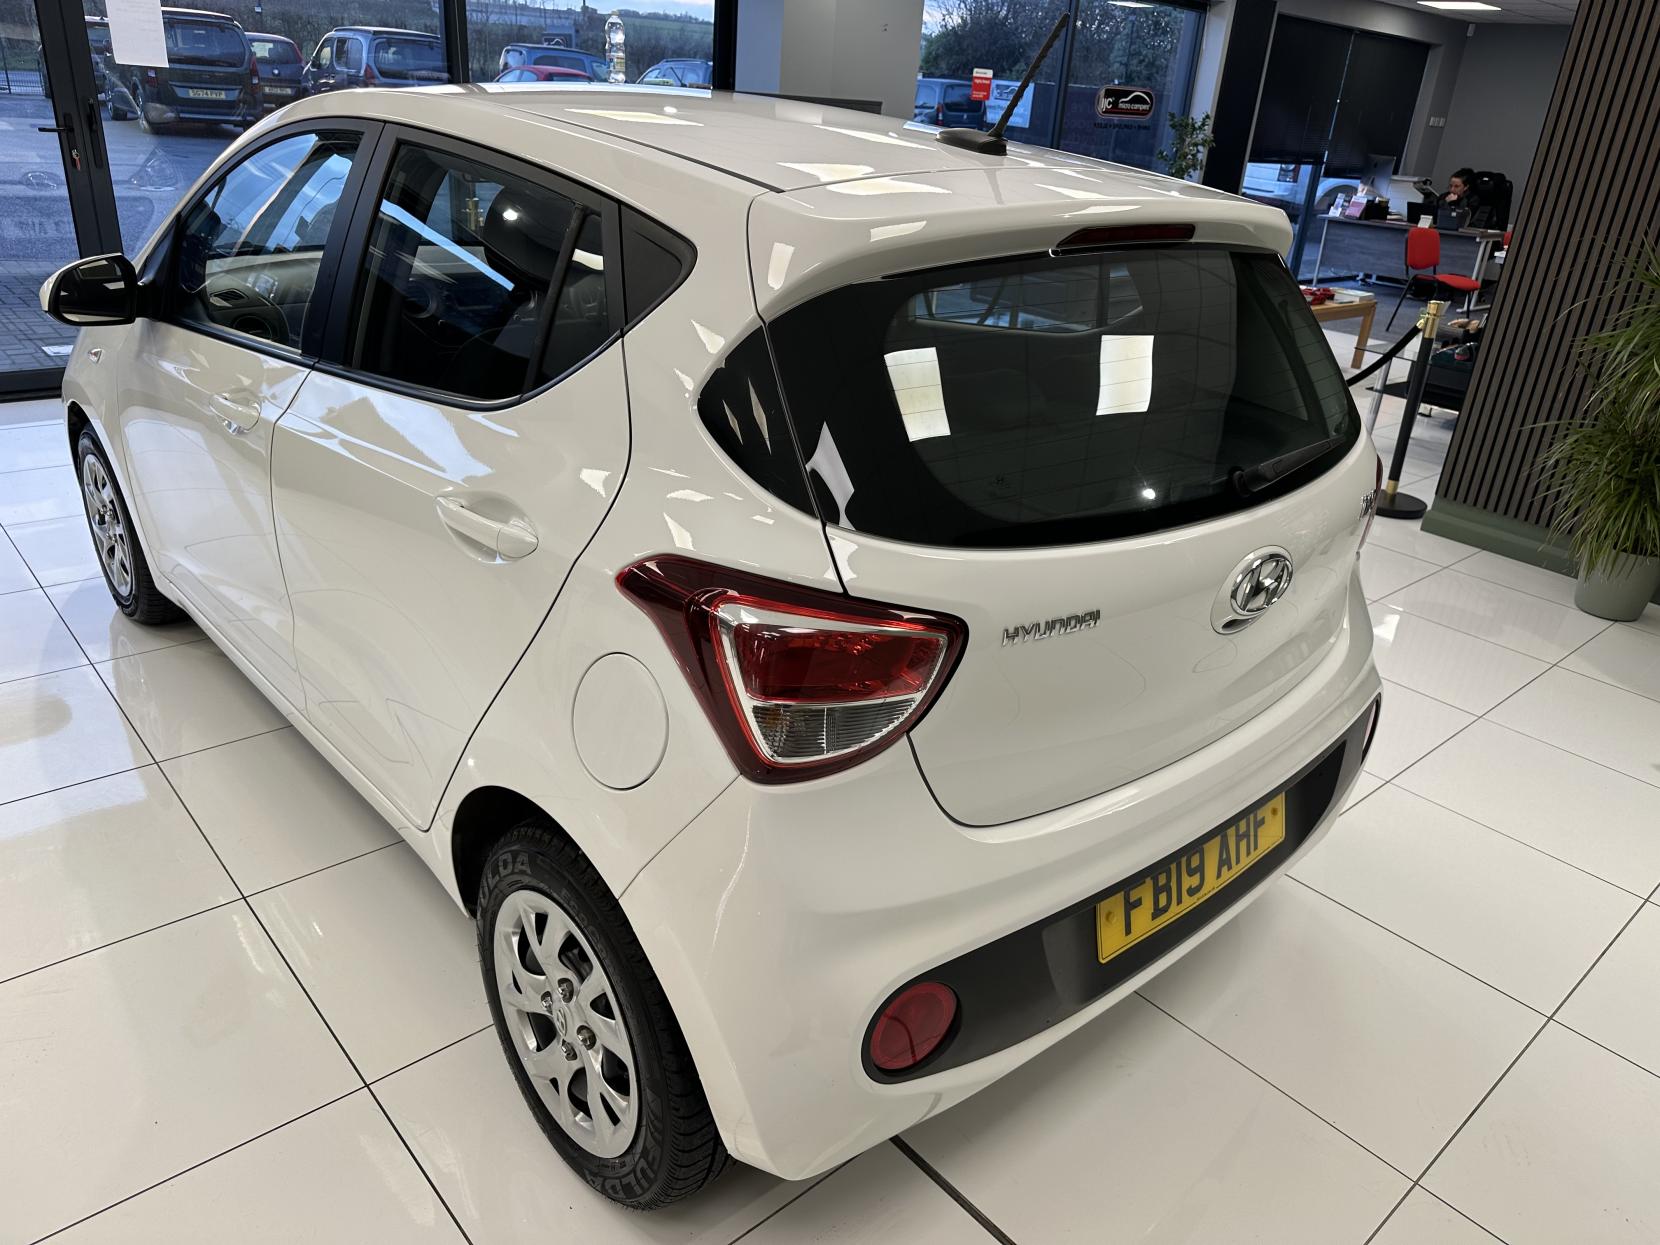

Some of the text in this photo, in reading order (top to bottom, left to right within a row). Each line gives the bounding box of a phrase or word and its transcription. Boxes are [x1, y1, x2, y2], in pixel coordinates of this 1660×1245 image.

[1002, 609, 1101, 647] HYUNDAI
[1123, 811, 1266, 937] FB19 AHF
